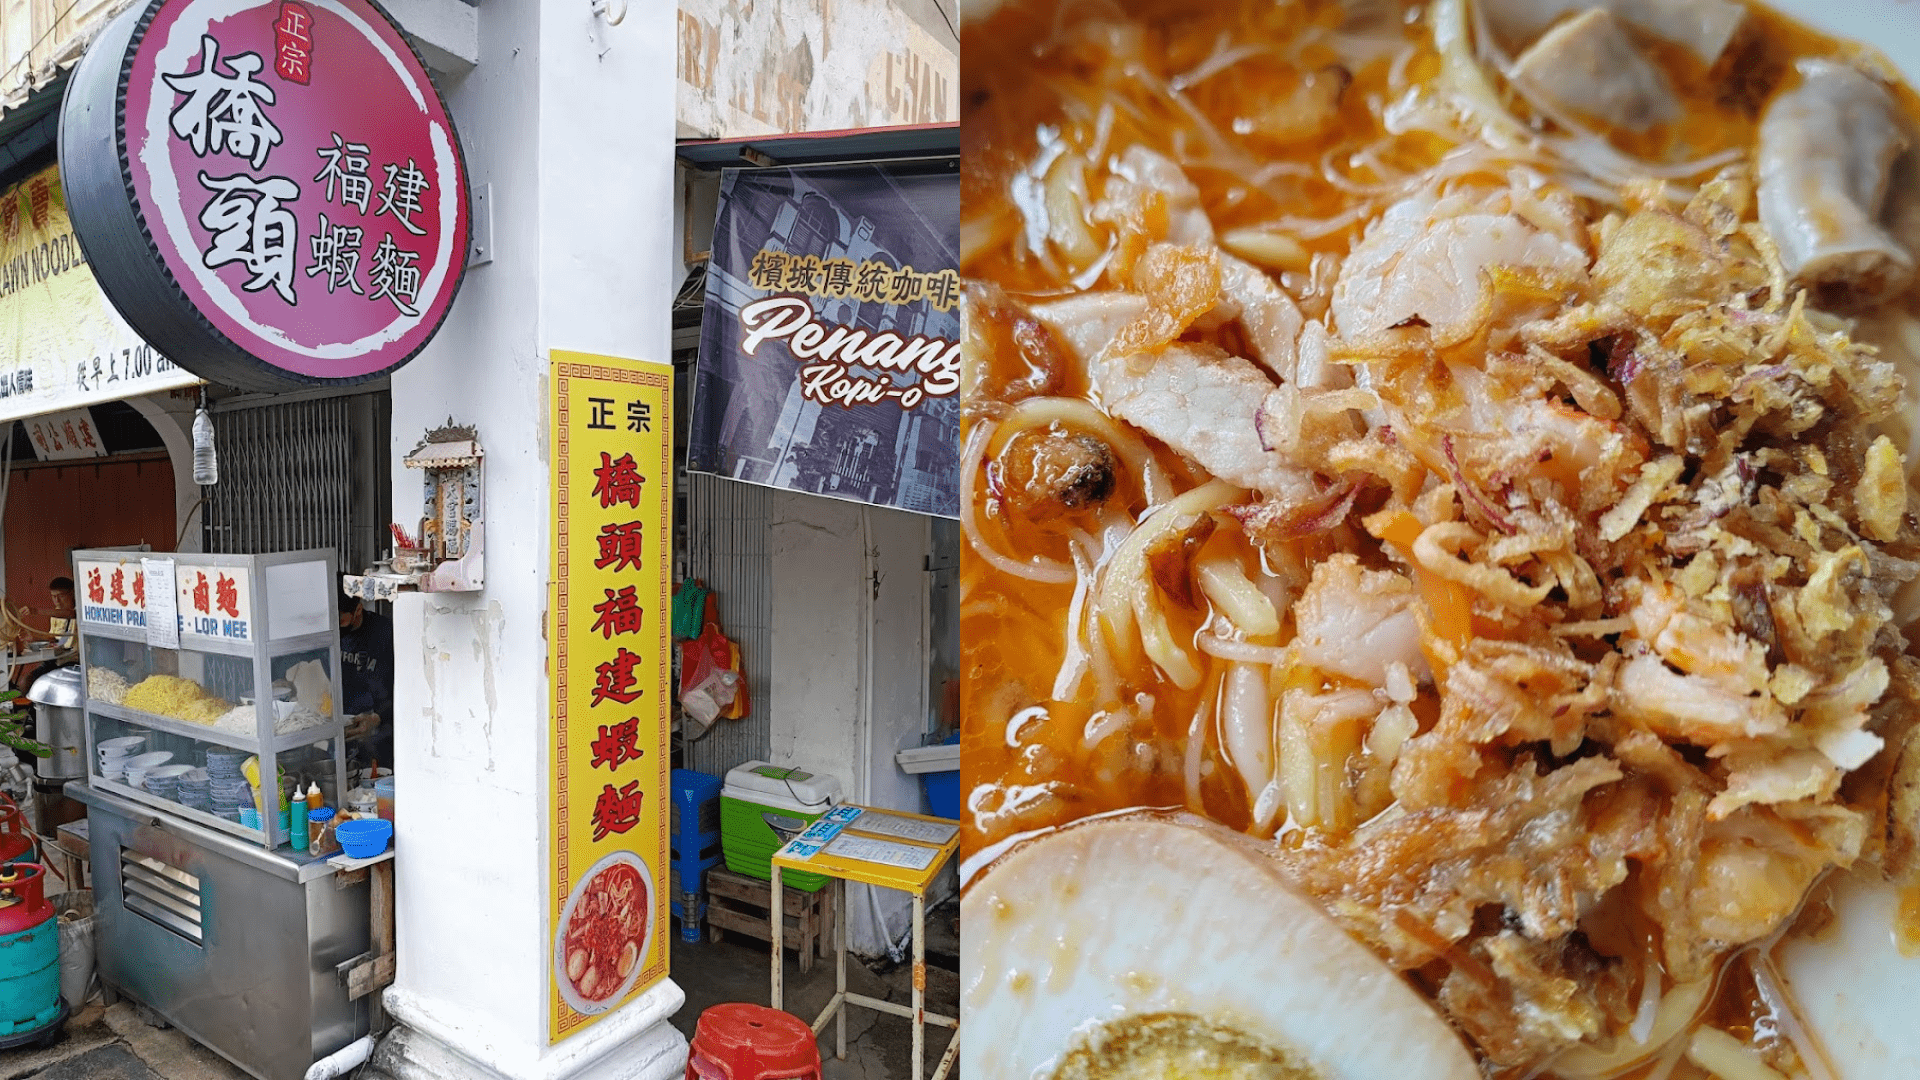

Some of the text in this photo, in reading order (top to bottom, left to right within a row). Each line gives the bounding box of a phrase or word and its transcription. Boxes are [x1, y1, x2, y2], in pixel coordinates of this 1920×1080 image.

[280, 11, 309, 76] 正宗
[162, 34, 301, 306] 橋頭
[314, 132, 430, 237] 福建
[0, 231, 87, 298] AWN NOODL
[305, 213, 421, 317] 蝦麵
[751, 251, 959, 310] 檳城傳統咖啡
[122, 343, 152, 380] 7.00
[741, 297, 960, 395] Penang
[587, 396, 651, 434] 正宗
[803, 363, 923, 406] Kopi-o
[84, 605, 123, 625] HOKKIEN
[195, 617, 218, 636] LOR
[222, 620, 248, 639] MEE
[590, 451, 645, 843] 橋頭福建蝦麵
